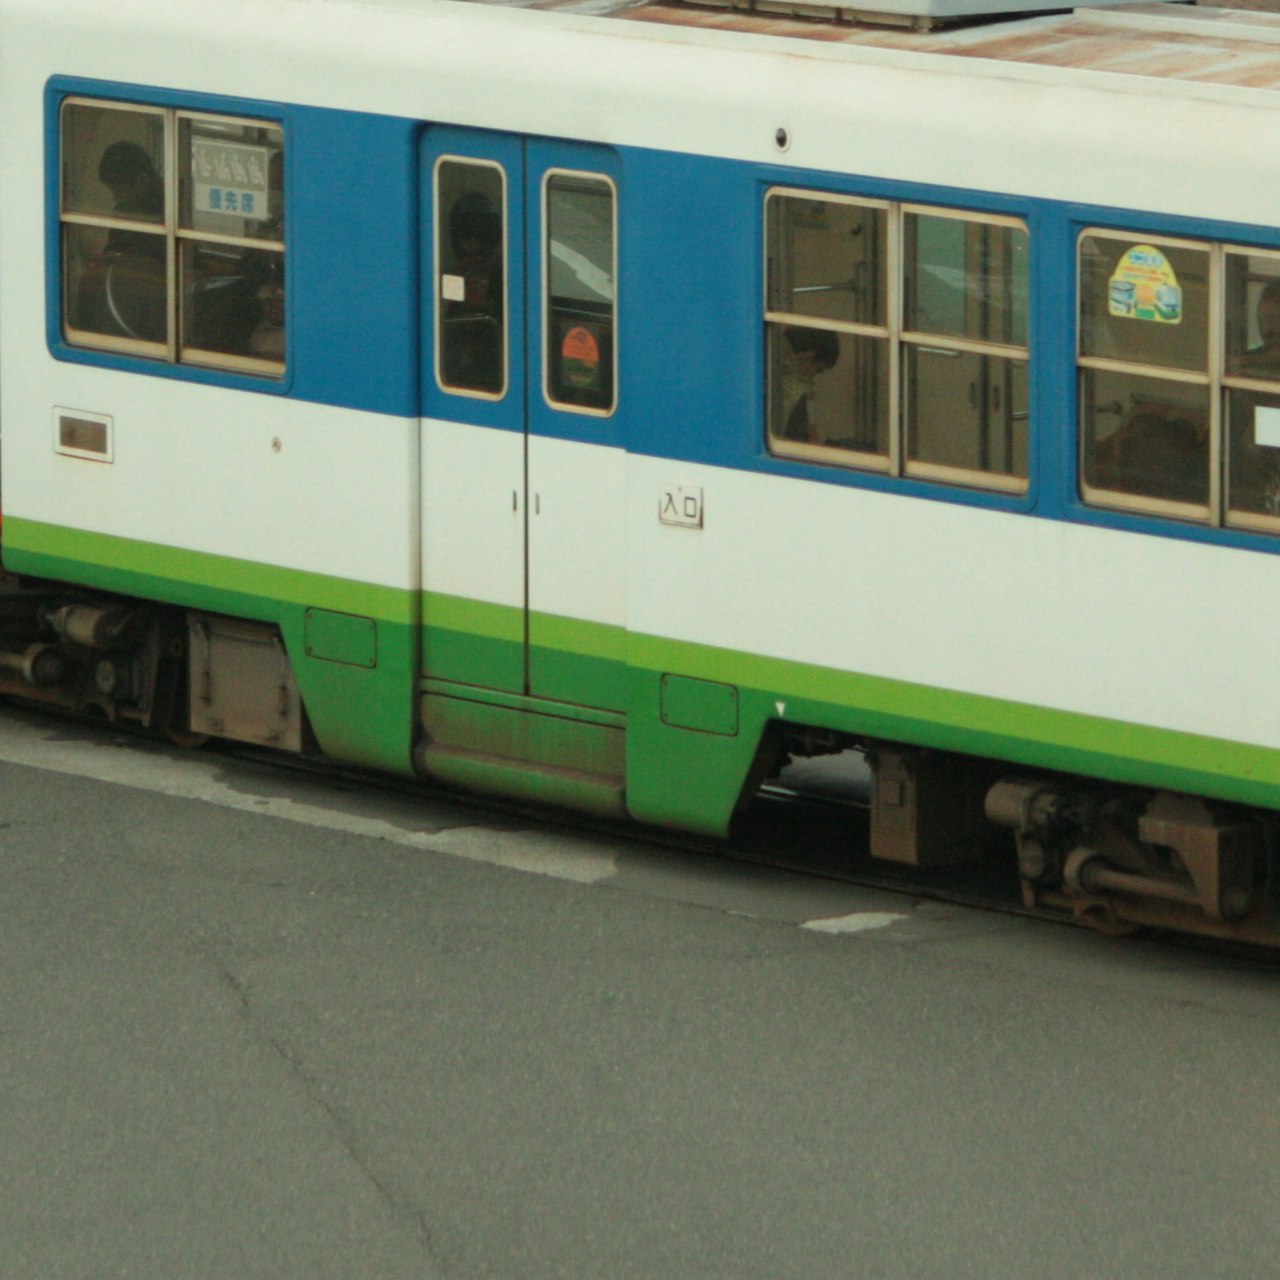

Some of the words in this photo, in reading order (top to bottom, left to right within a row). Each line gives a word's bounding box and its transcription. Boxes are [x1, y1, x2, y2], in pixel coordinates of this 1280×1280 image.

[208, 187, 256, 215] 優先席
[663, 491, 698, 519] 入口
